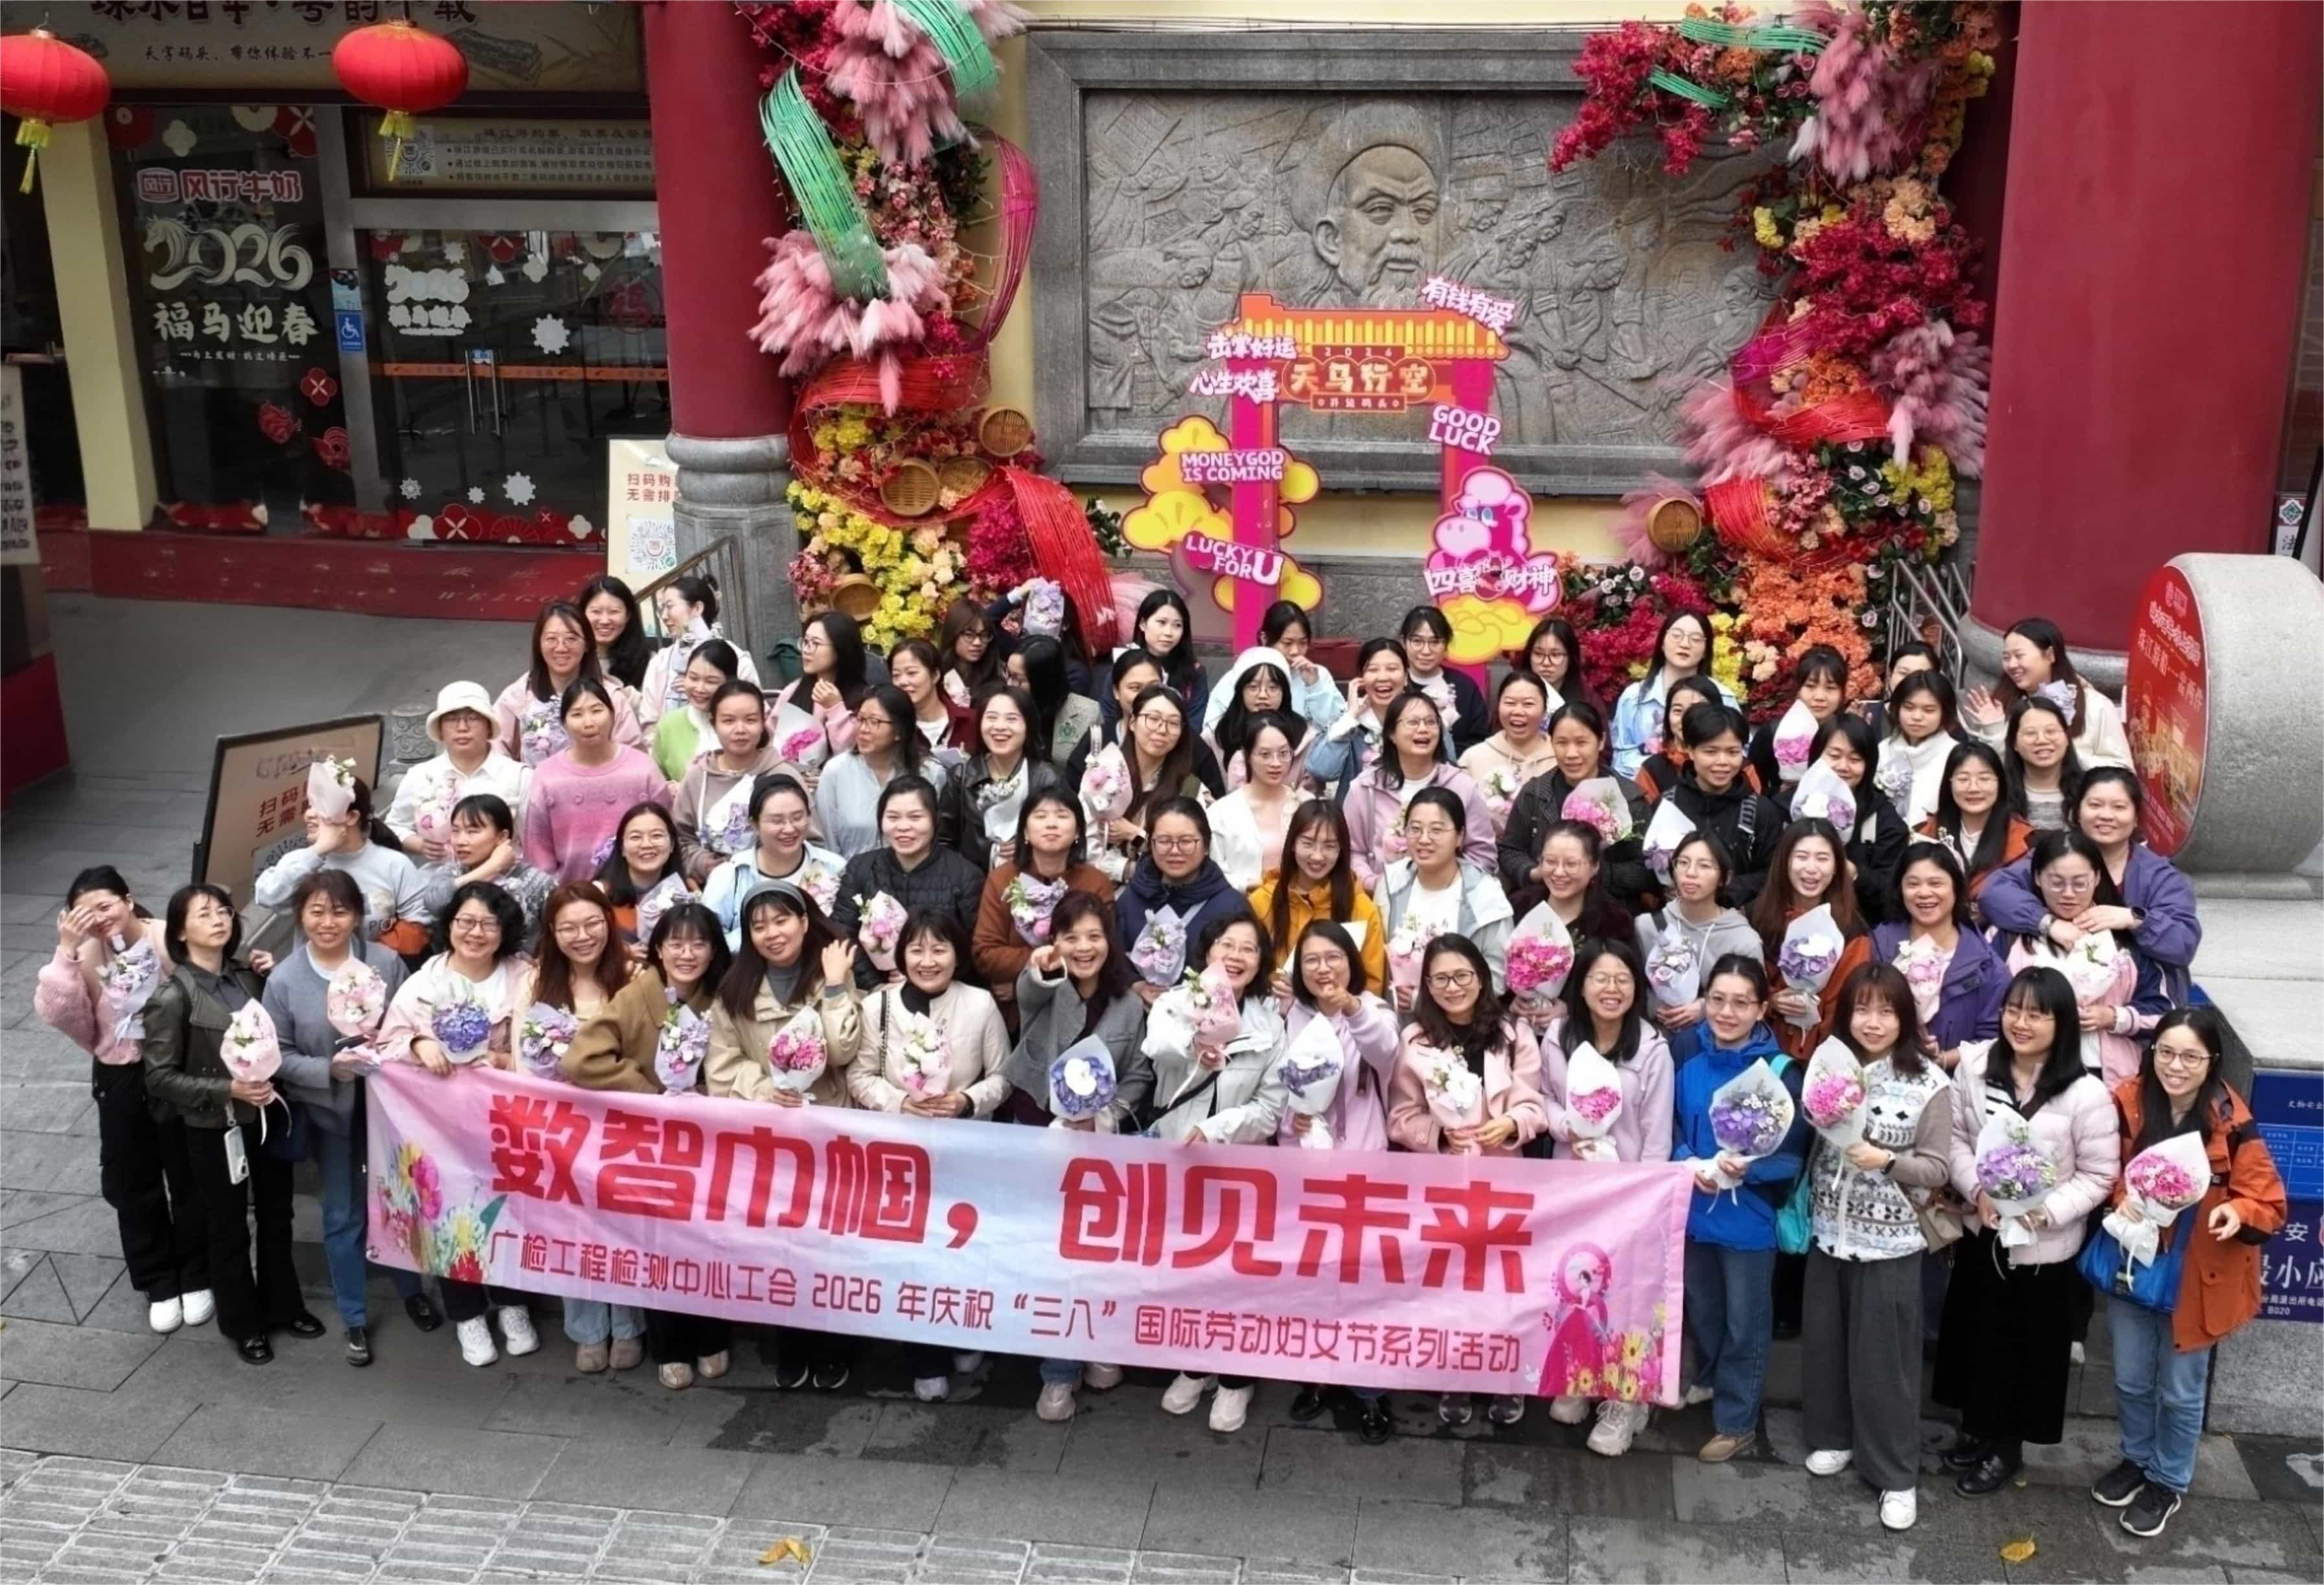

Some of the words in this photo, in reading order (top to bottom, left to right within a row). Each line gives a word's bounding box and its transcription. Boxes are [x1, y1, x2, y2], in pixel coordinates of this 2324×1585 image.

[180, 170, 303, 203] 风行牛奶
[143, 214, 313, 291] 2026
[153, 301, 319, 346] 福马迎春
[1421, 276, 1515, 336] 有钱有爱
[1190, 367, 1280, 404] 心生欢喜
[1290, 362, 1428, 395] 天马行空
[1432, 404, 1501, 437] GOOD
[1429, 421, 1495, 456] LUCK
[1181, 451, 1284, 468] MONEYGOD
[1184, 467, 1203, 482] IS
[1206, 466, 1283, 481] COMING
[1185, 535, 1253, 563] LUCKY
[1213, 556, 1252, 579] FOR
[1252, 551, 1284, 586] U
[260, 780, 308, 818] 扫码
[2273, 1221, 2308, 1243] 安
[489, 1229, 797, 1307] 广检工程检测中心工会
[812, 1273, 882, 1314] 2026
